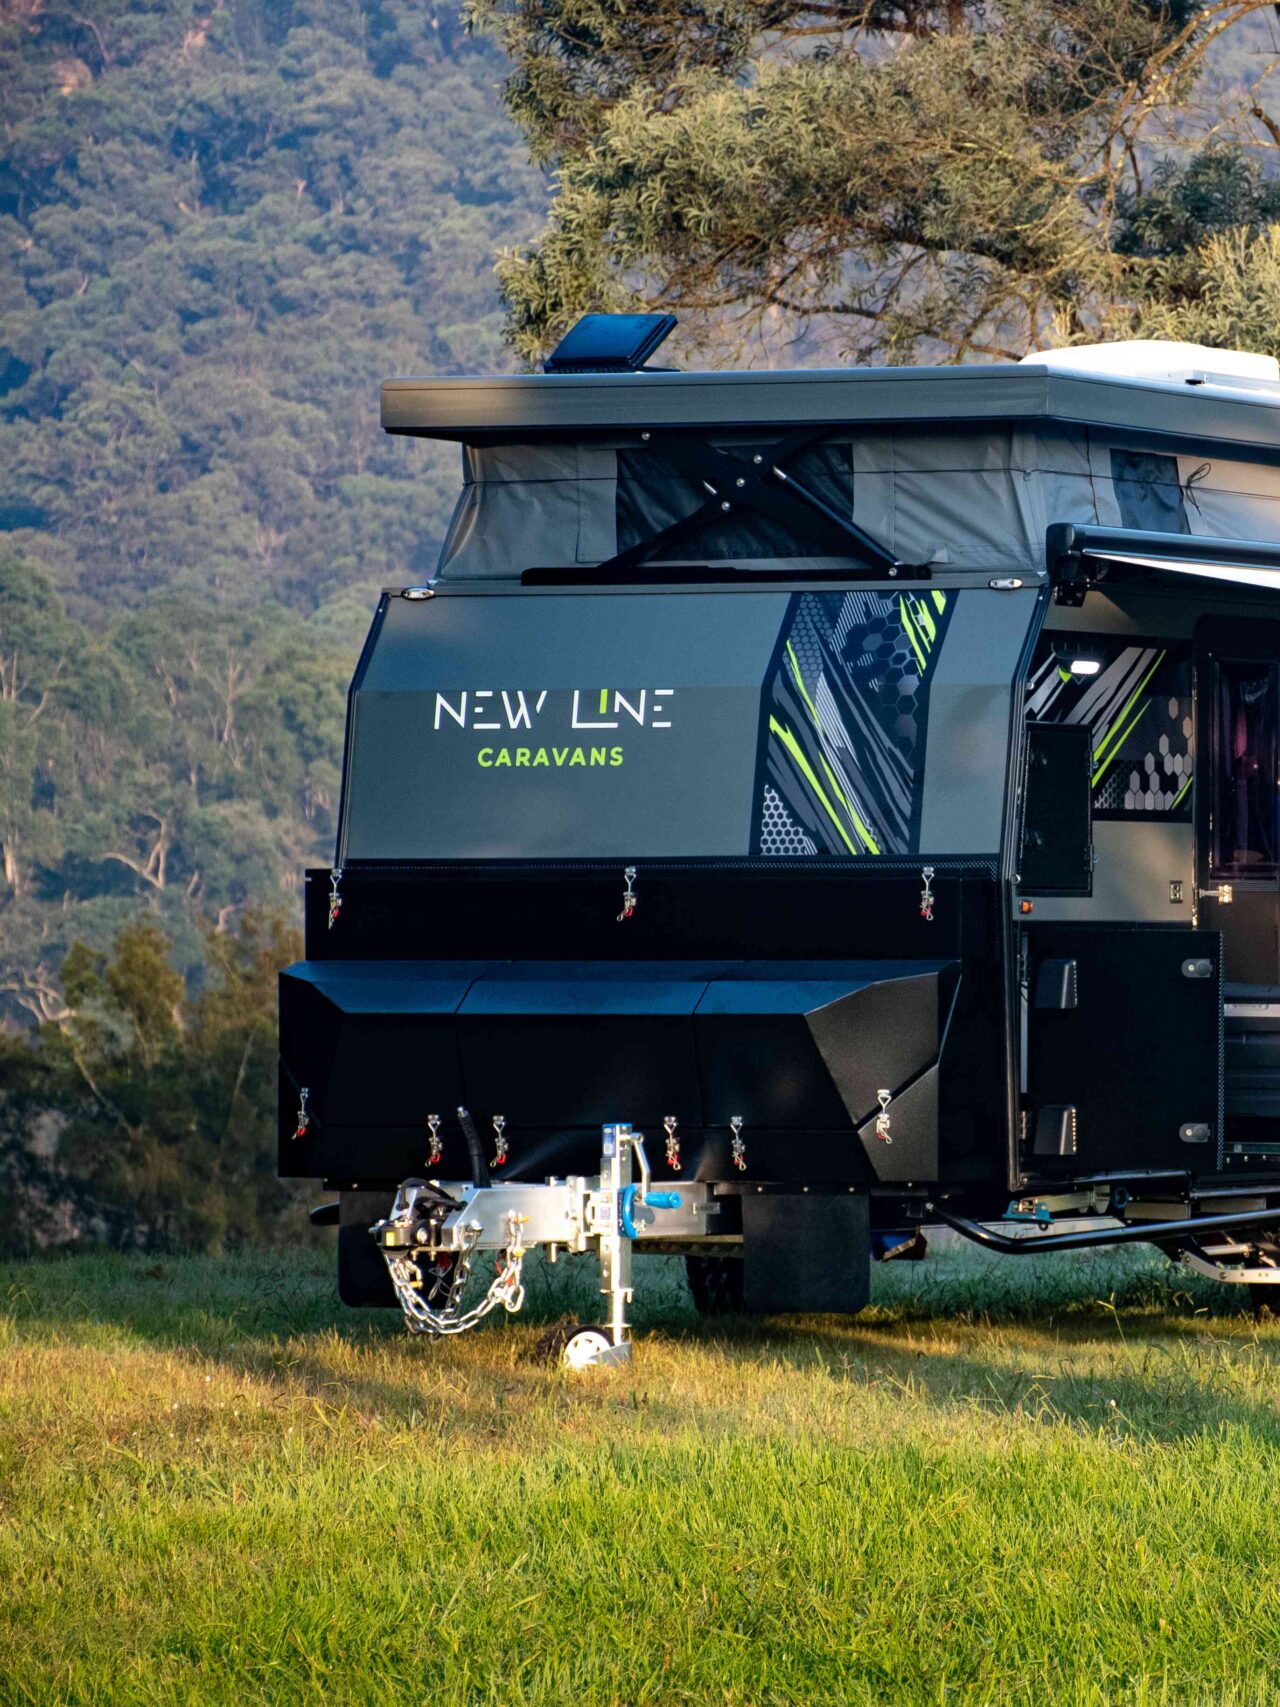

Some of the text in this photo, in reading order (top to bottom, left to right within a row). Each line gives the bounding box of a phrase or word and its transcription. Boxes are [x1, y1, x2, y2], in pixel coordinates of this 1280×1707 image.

[434, 689, 674, 730] NEW LINE
[477, 747, 623, 767] CARAVANS
